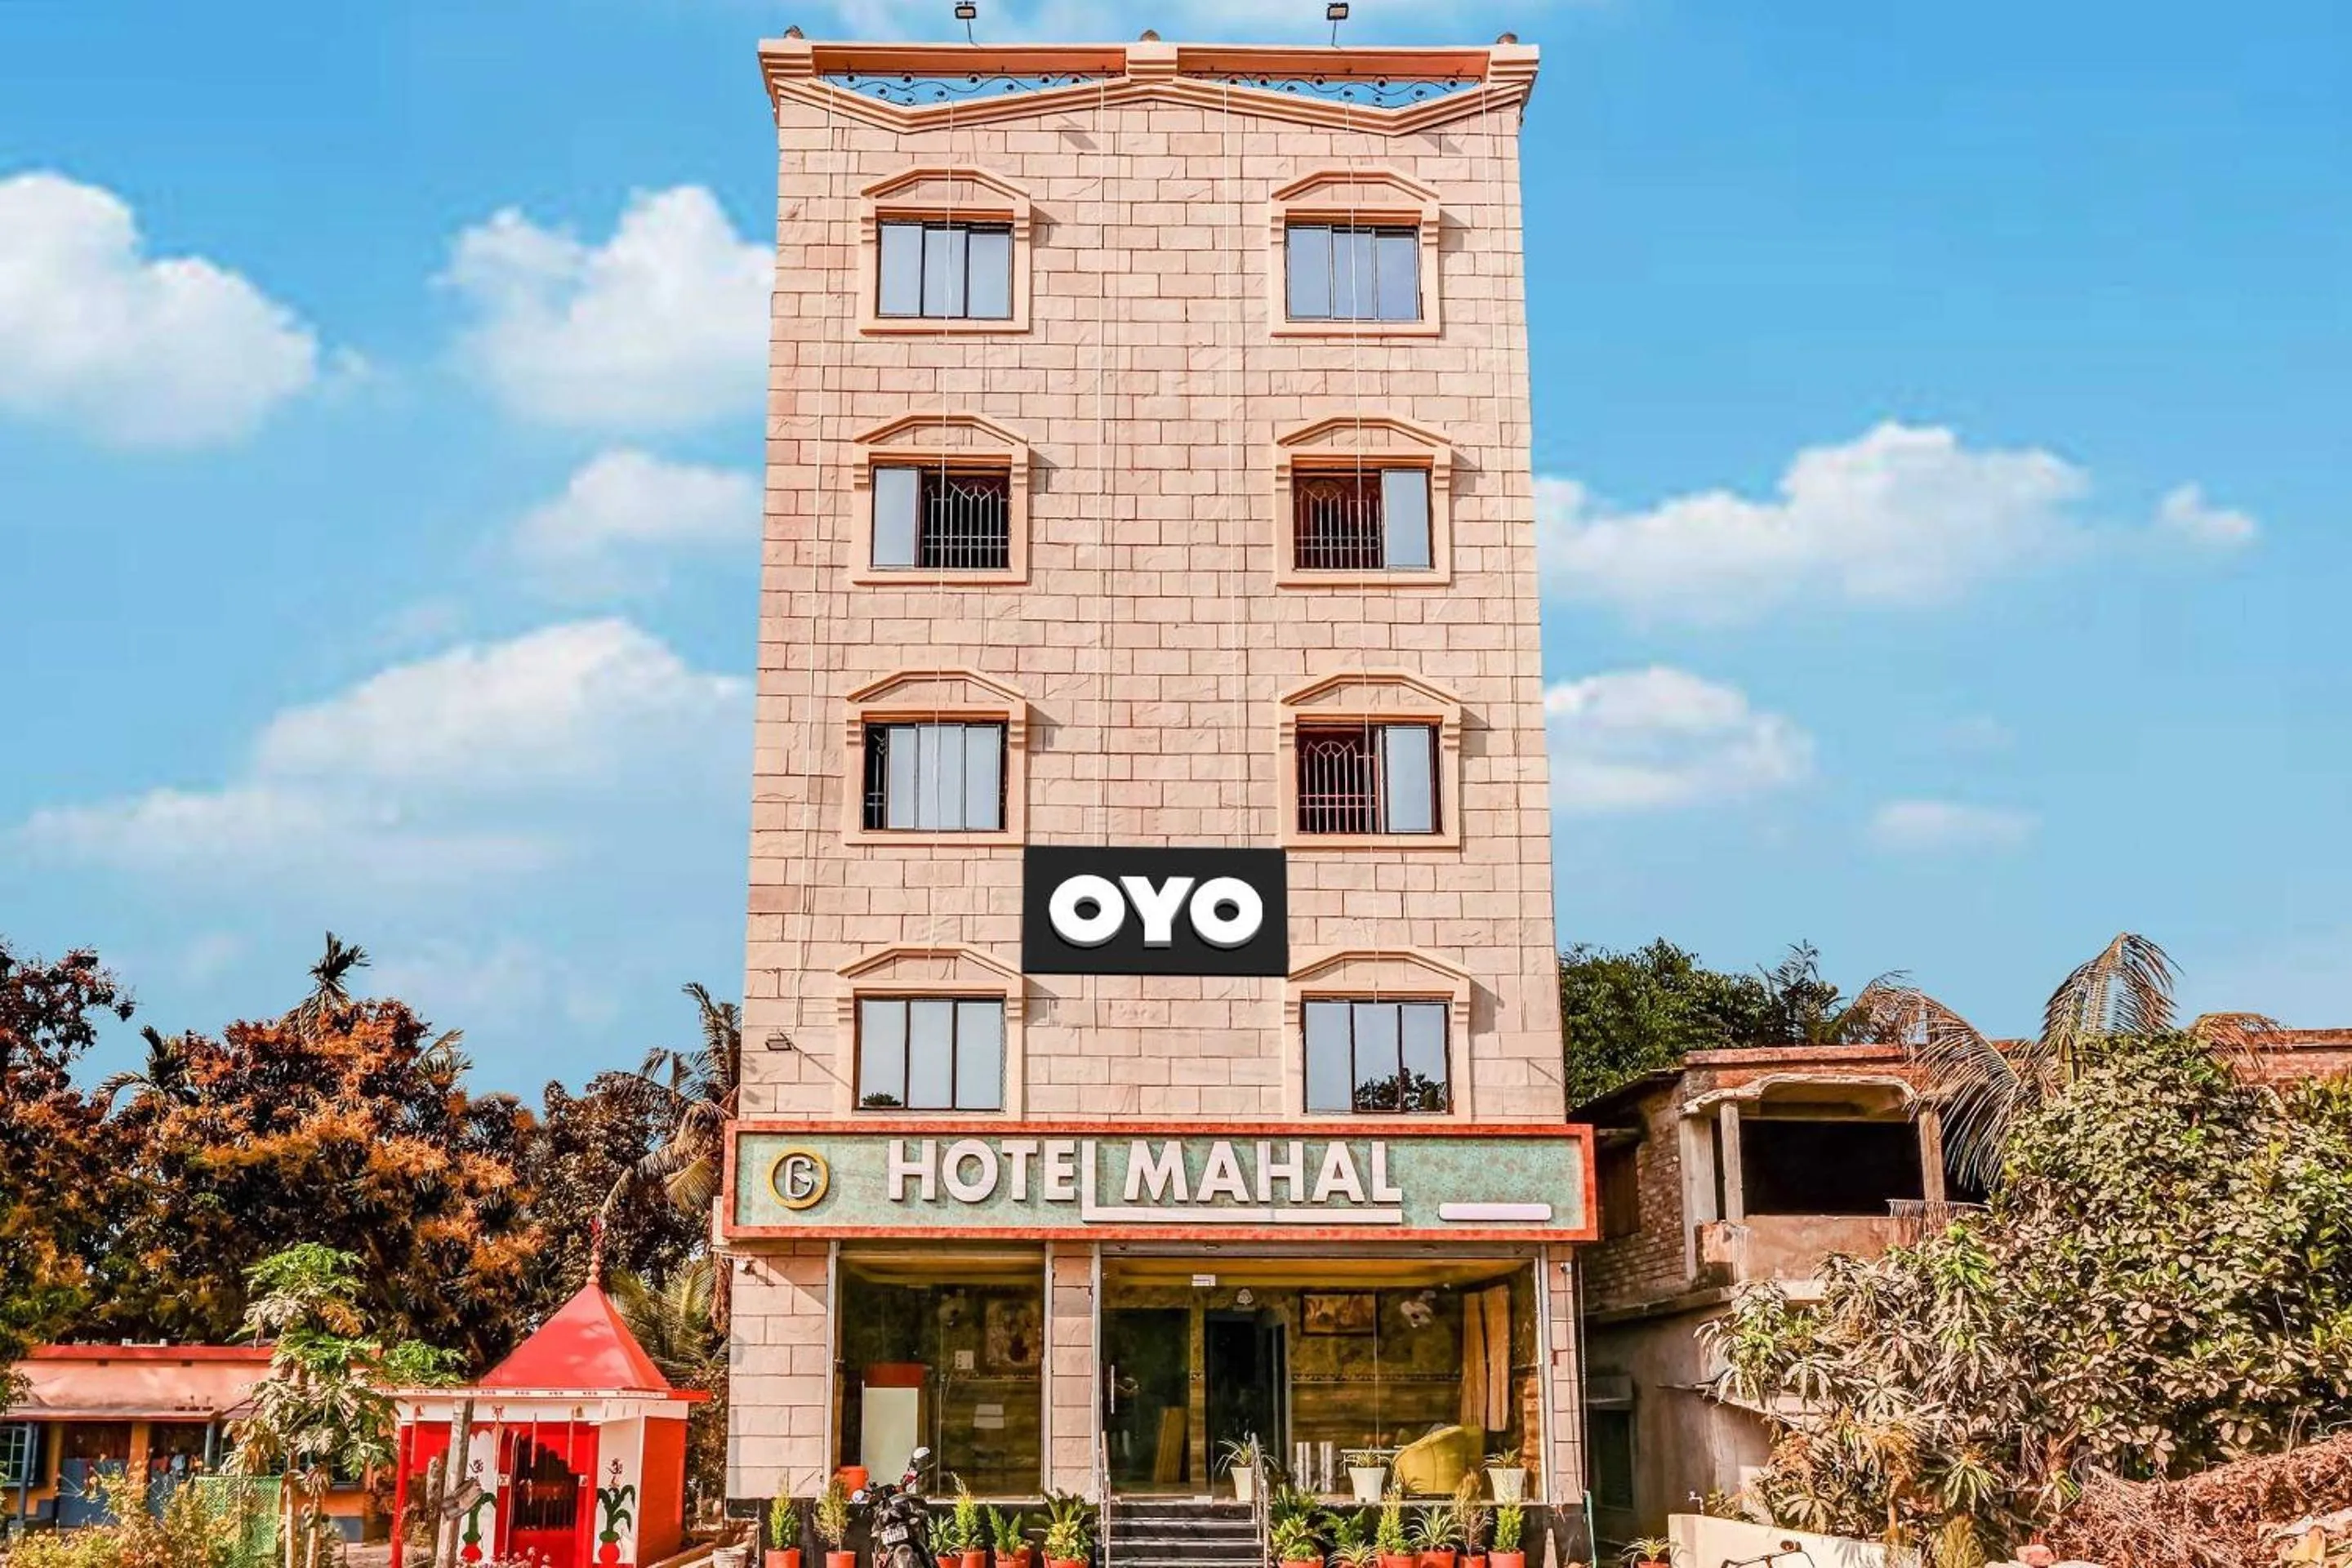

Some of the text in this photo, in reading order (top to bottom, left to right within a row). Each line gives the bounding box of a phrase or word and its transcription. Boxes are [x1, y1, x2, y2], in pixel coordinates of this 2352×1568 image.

[1049, 875, 1263, 949] OYO
[889, 1138, 1402, 1222] HOTEL MAHAL
